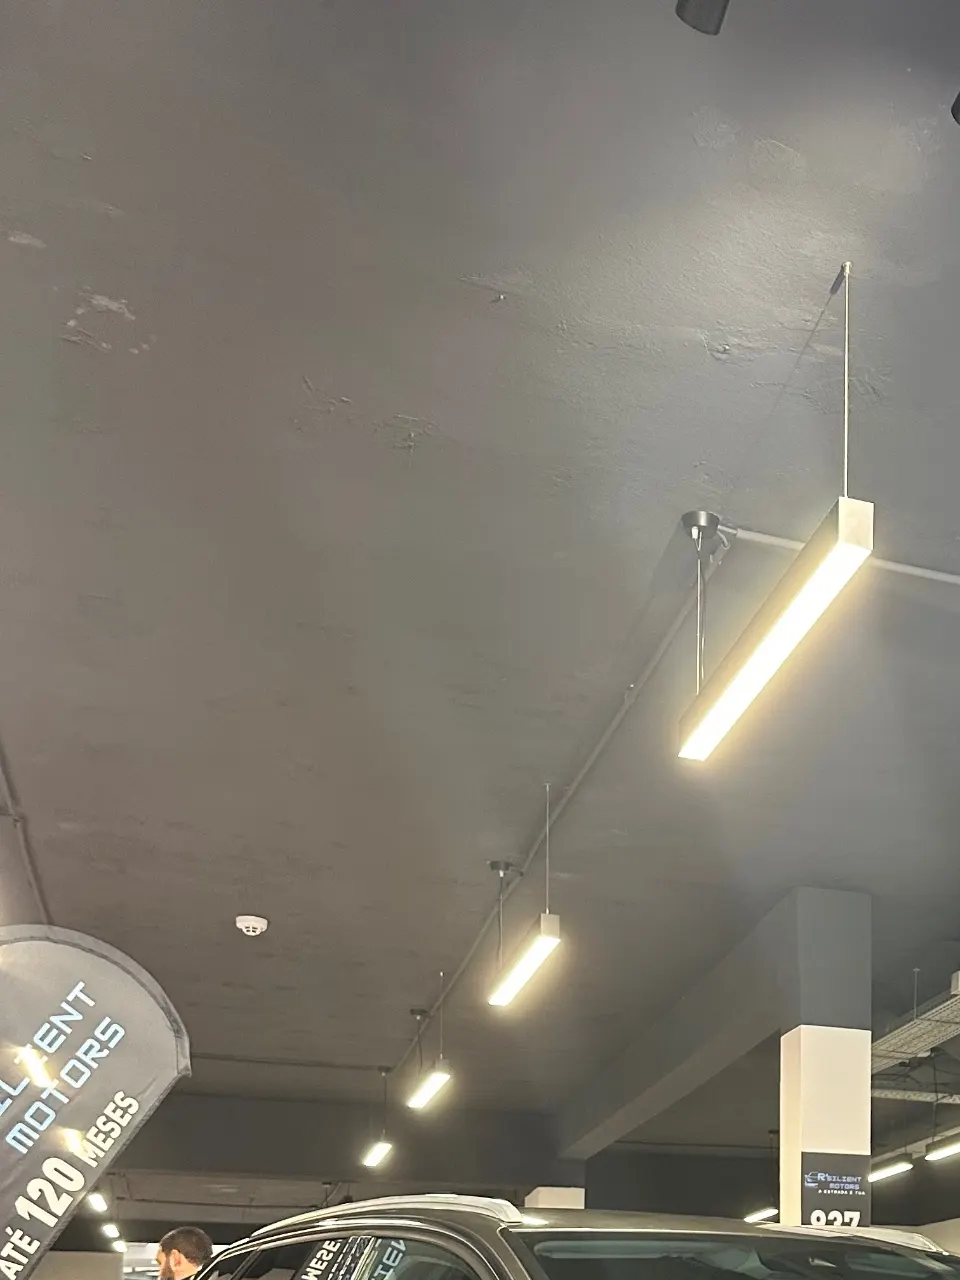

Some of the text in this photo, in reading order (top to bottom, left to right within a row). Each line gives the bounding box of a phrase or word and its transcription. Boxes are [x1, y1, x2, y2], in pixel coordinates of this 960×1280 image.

[5, 1016, 126, 1155] MOTORS
[14, 1157, 86, 1229] 120
[71, 1090, 140, 1169] MESES
